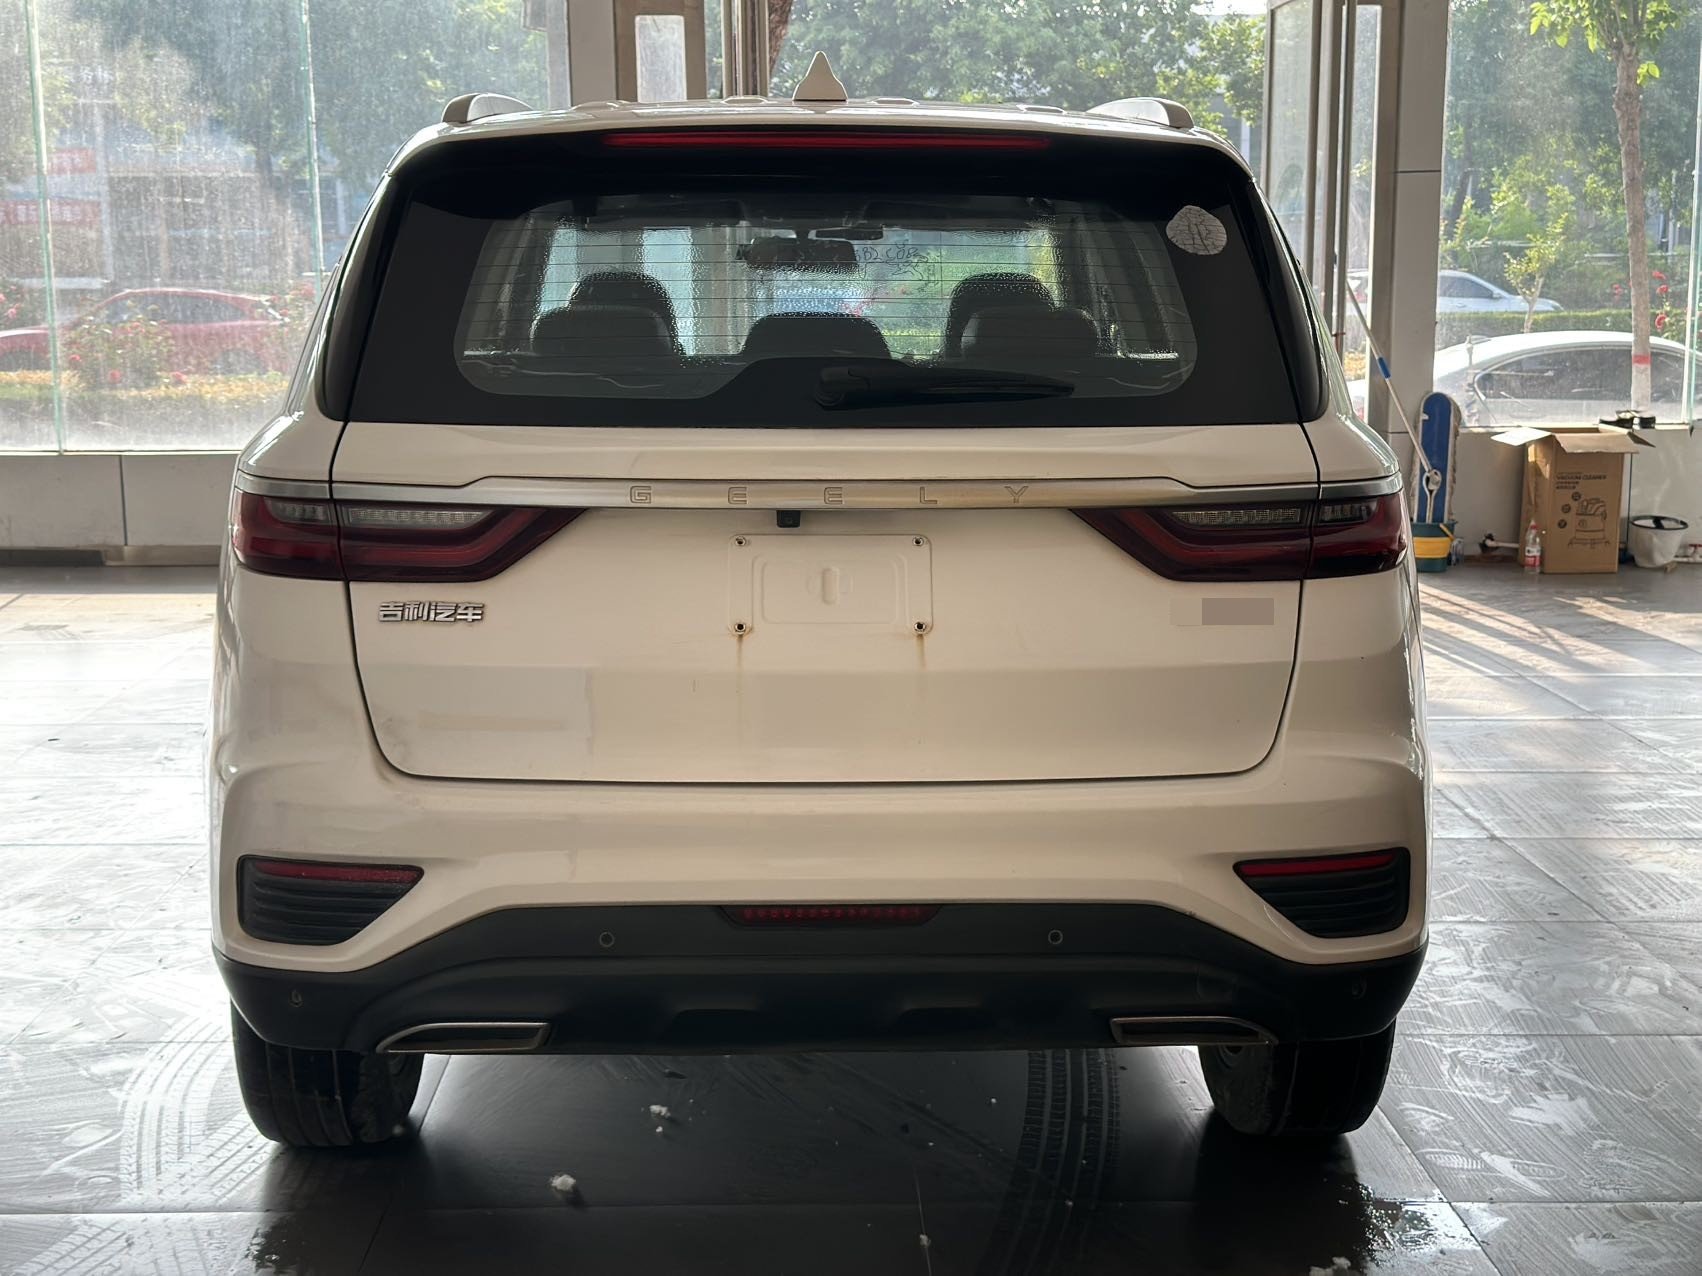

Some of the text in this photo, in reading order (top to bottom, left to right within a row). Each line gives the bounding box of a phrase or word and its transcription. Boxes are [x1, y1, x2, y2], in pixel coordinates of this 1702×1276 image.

[629, 485, 1029, 505] GEELY
[379, 601, 484, 622] 吉利汽车
